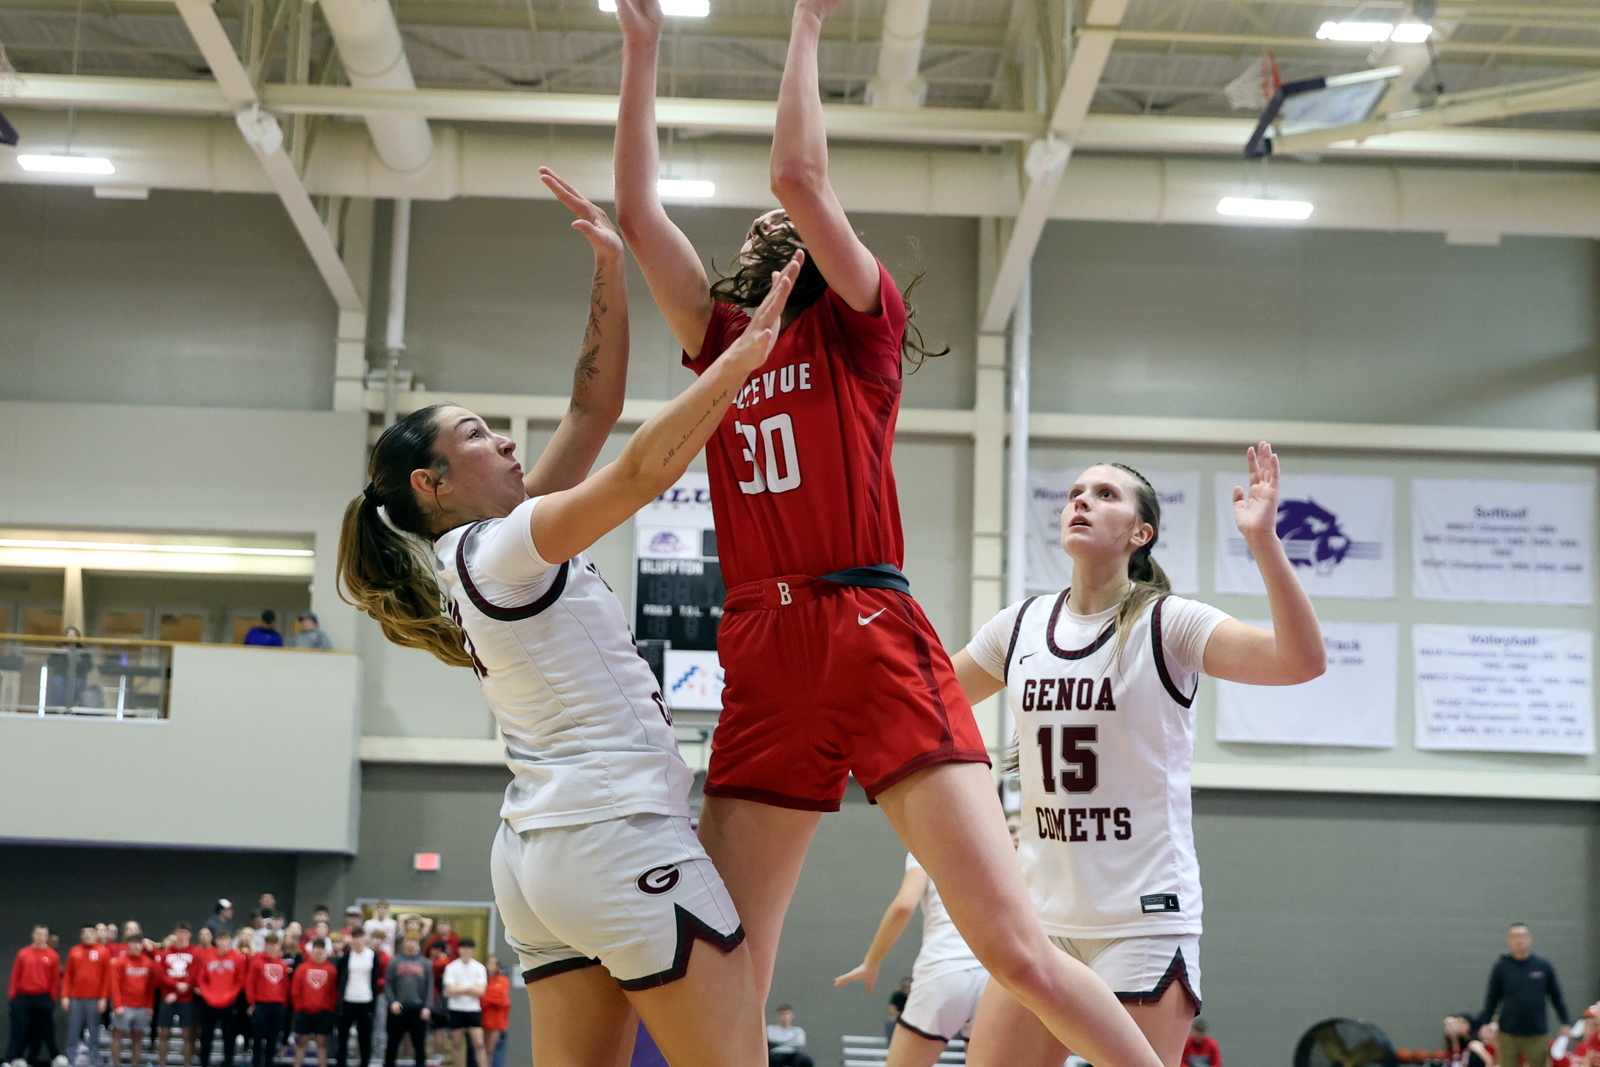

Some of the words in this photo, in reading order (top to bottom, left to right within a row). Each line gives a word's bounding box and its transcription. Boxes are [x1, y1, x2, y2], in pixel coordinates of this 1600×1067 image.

[734, 413, 801, 495] 30
[1474, 506, 1528, 520] Softball
[640, 559, 704, 575] BLUFFTON
[777, 582, 792, 606] B
[1467, 633, 1538, 650] Volleyball
[1022, 677, 1117, 713] GENOA
[1036, 724, 1099, 795] 15
[1036, 807, 1132, 843] COMETS
[637, 864, 680, 895] G
[1168, 898, 1176, 907] L
